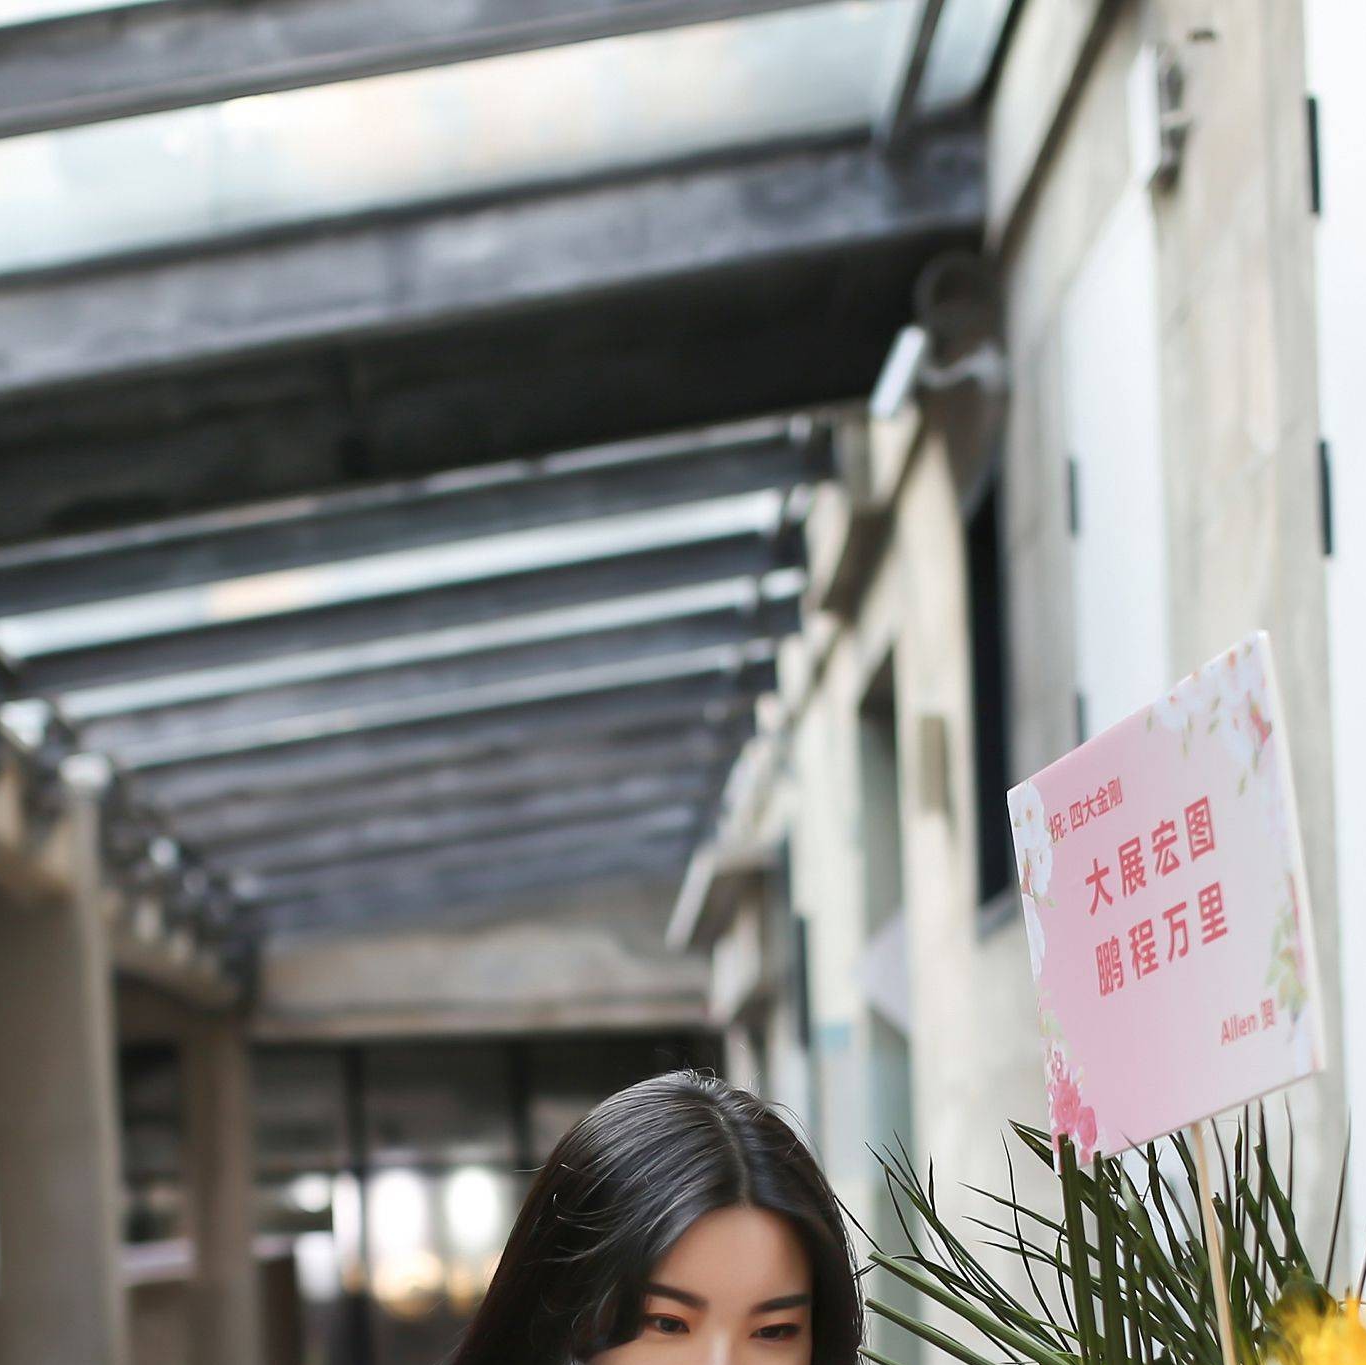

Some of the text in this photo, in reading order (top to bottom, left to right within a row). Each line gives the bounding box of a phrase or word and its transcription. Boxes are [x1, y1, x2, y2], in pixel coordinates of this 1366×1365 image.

[1085, 796, 1215, 916] 大展宏图
[1095, 881, 1228, 997] 鹏程万里
